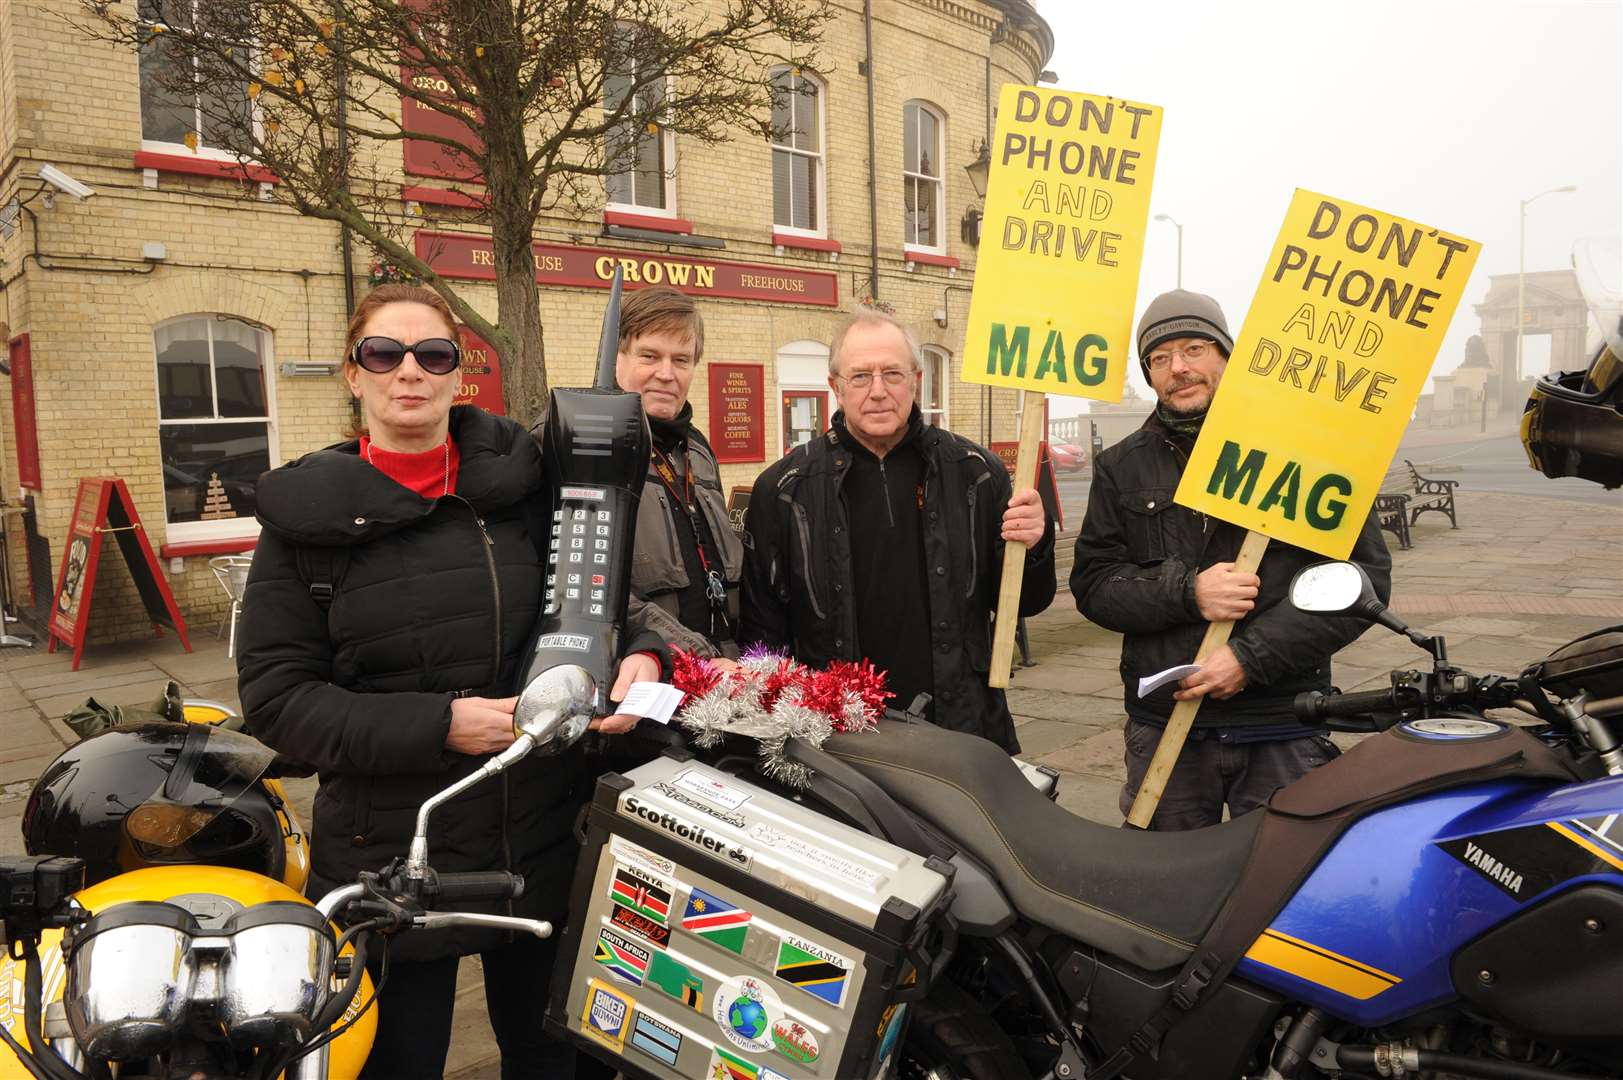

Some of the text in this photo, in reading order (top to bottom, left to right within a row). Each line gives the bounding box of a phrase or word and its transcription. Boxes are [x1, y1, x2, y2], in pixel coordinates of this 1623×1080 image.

[1014, 90, 1153, 140] DON'T
[1001, 133, 1141, 185] PHONE
[1023, 179, 1113, 221] AND
[1002, 216, 1122, 267] DRIVE
[1306, 200, 1469, 280] DON'T
[594, 255, 715, 288] CROWN
[740, 274, 805, 292] FREEHOUSE
[1272, 244, 1441, 329] PHONE
[1282, 303, 1384, 358] AND
[986, 323, 1109, 387] MAG
[1248, 338, 1397, 414] DRIVE
[723, 416, 752, 424] LIQUORS
[728, 401, 747, 410] ALES
[724, 431, 752, 439] COFFEE
[998, 447, 1018, 457] CRO
[1206, 440, 1353, 532] MAG
[577, 511, 583, 519] 2
[600, 512, 606, 520] 3
[541, 635, 588, 649] PORTABLE PHONE
[624, 797, 726, 854] Scottoiler
[628, 865, 663, 888] KENYA
[1463, 841, 1524, 894] YAMAHA
[601, 929, 648, 960] SOUTH AFRICA
[788, 935, 844, 968] TANZANIA
[595, 989, 626, 1019] BIKER
[639, 1012, 681, 1039] BOTSWANA
[774, 1023, 817, 1058] WALES
